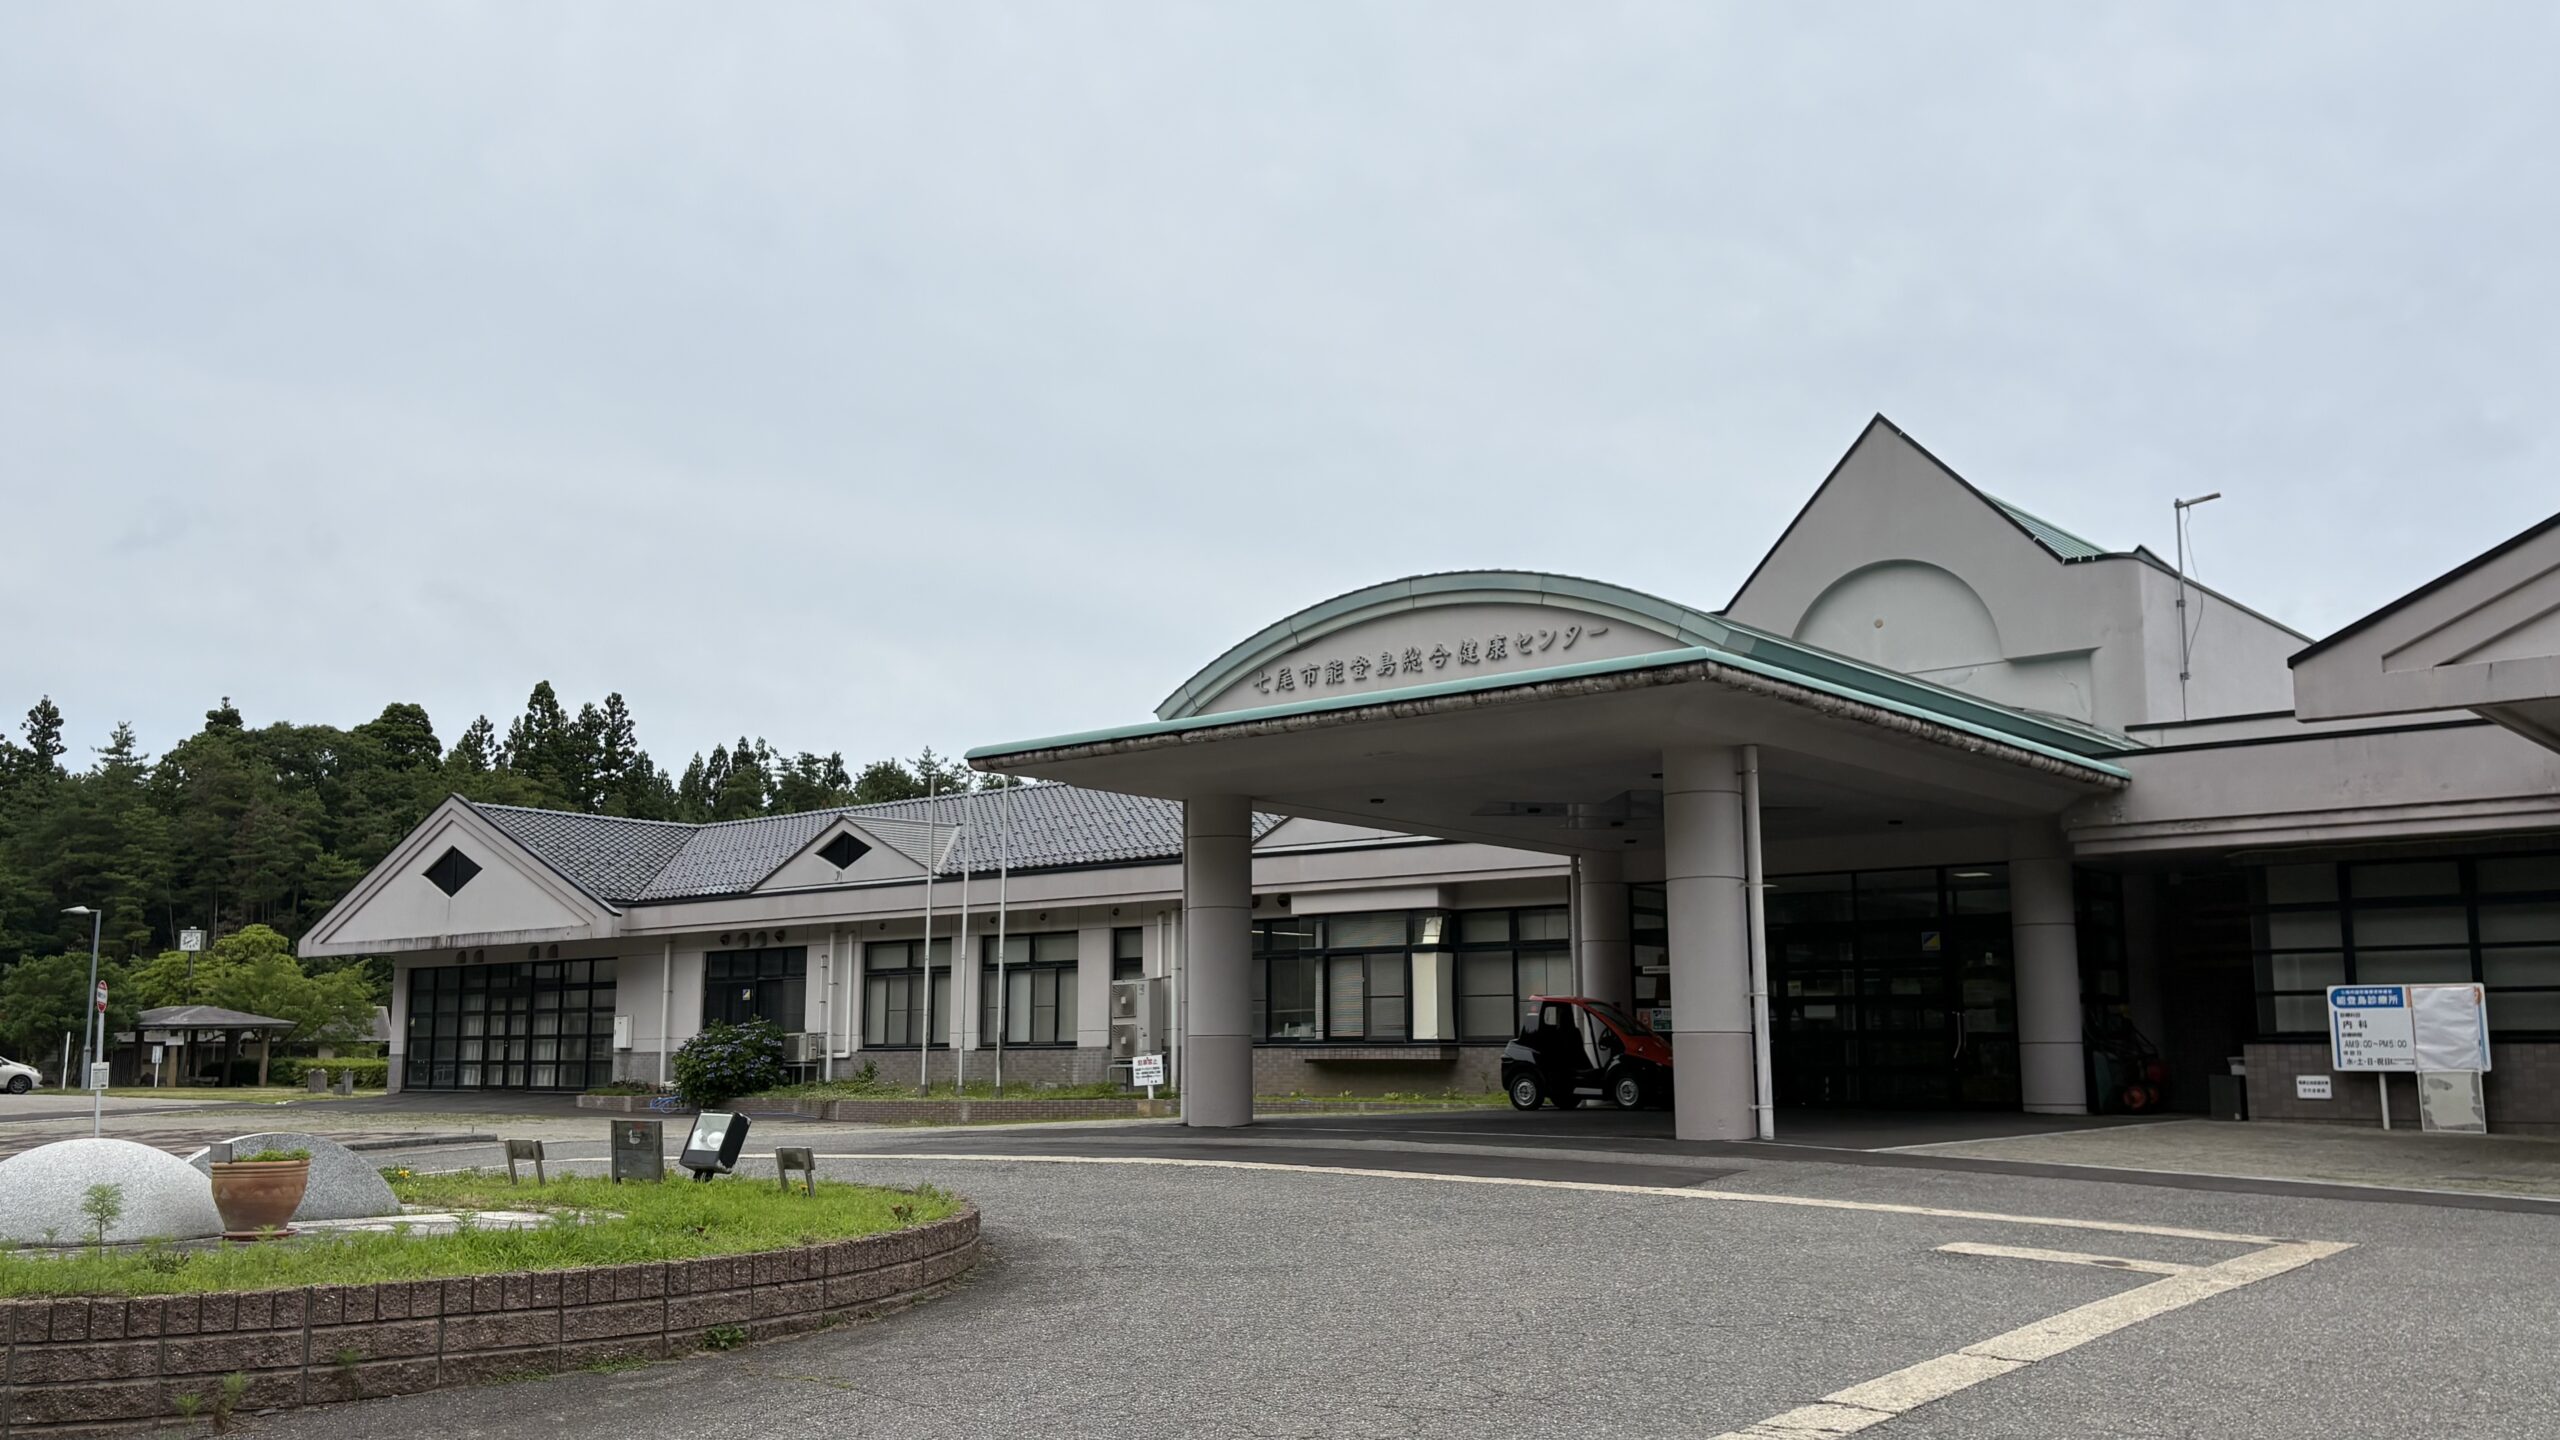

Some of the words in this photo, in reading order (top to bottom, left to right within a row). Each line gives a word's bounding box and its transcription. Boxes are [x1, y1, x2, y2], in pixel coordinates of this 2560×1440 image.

[1253, 624, 1609, 695] 七尾市能登島総合健康センター
[2336, 995, 2398, 1006] 能登島診療所
